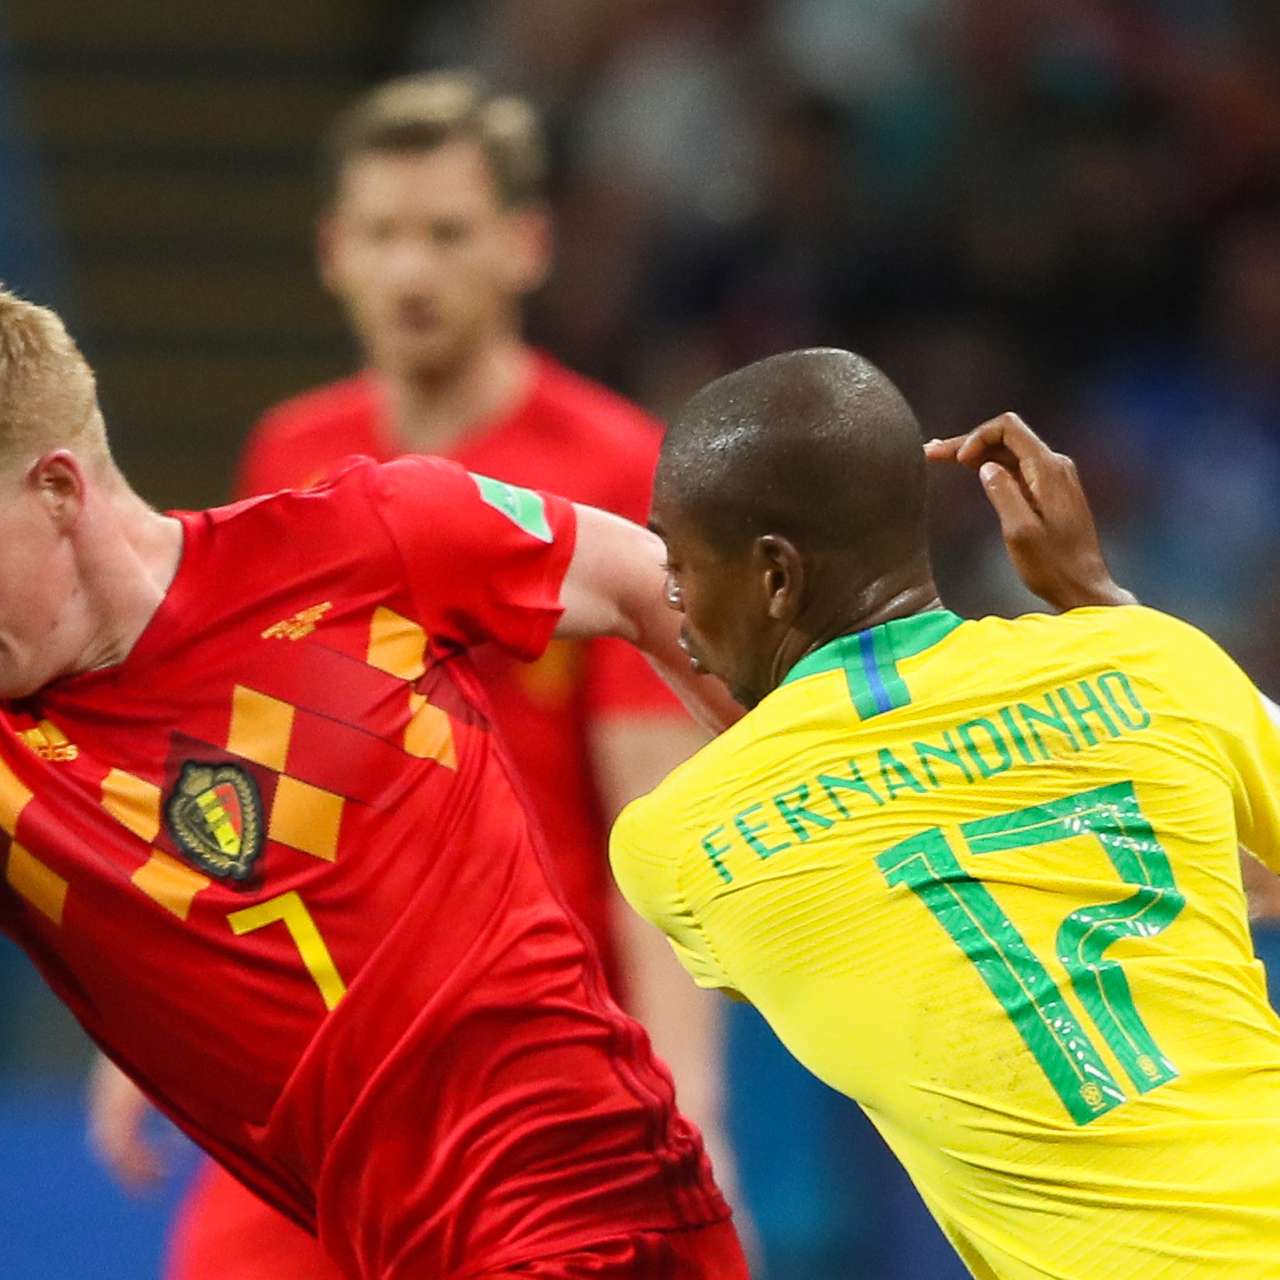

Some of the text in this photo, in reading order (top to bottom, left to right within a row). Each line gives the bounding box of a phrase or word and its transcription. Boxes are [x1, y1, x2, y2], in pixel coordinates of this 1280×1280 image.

[699, 670, 1152, 885] FERNANDINHO
[227, 891, 347, 1011] 7
[874, 779, 1187, 1127] 17
